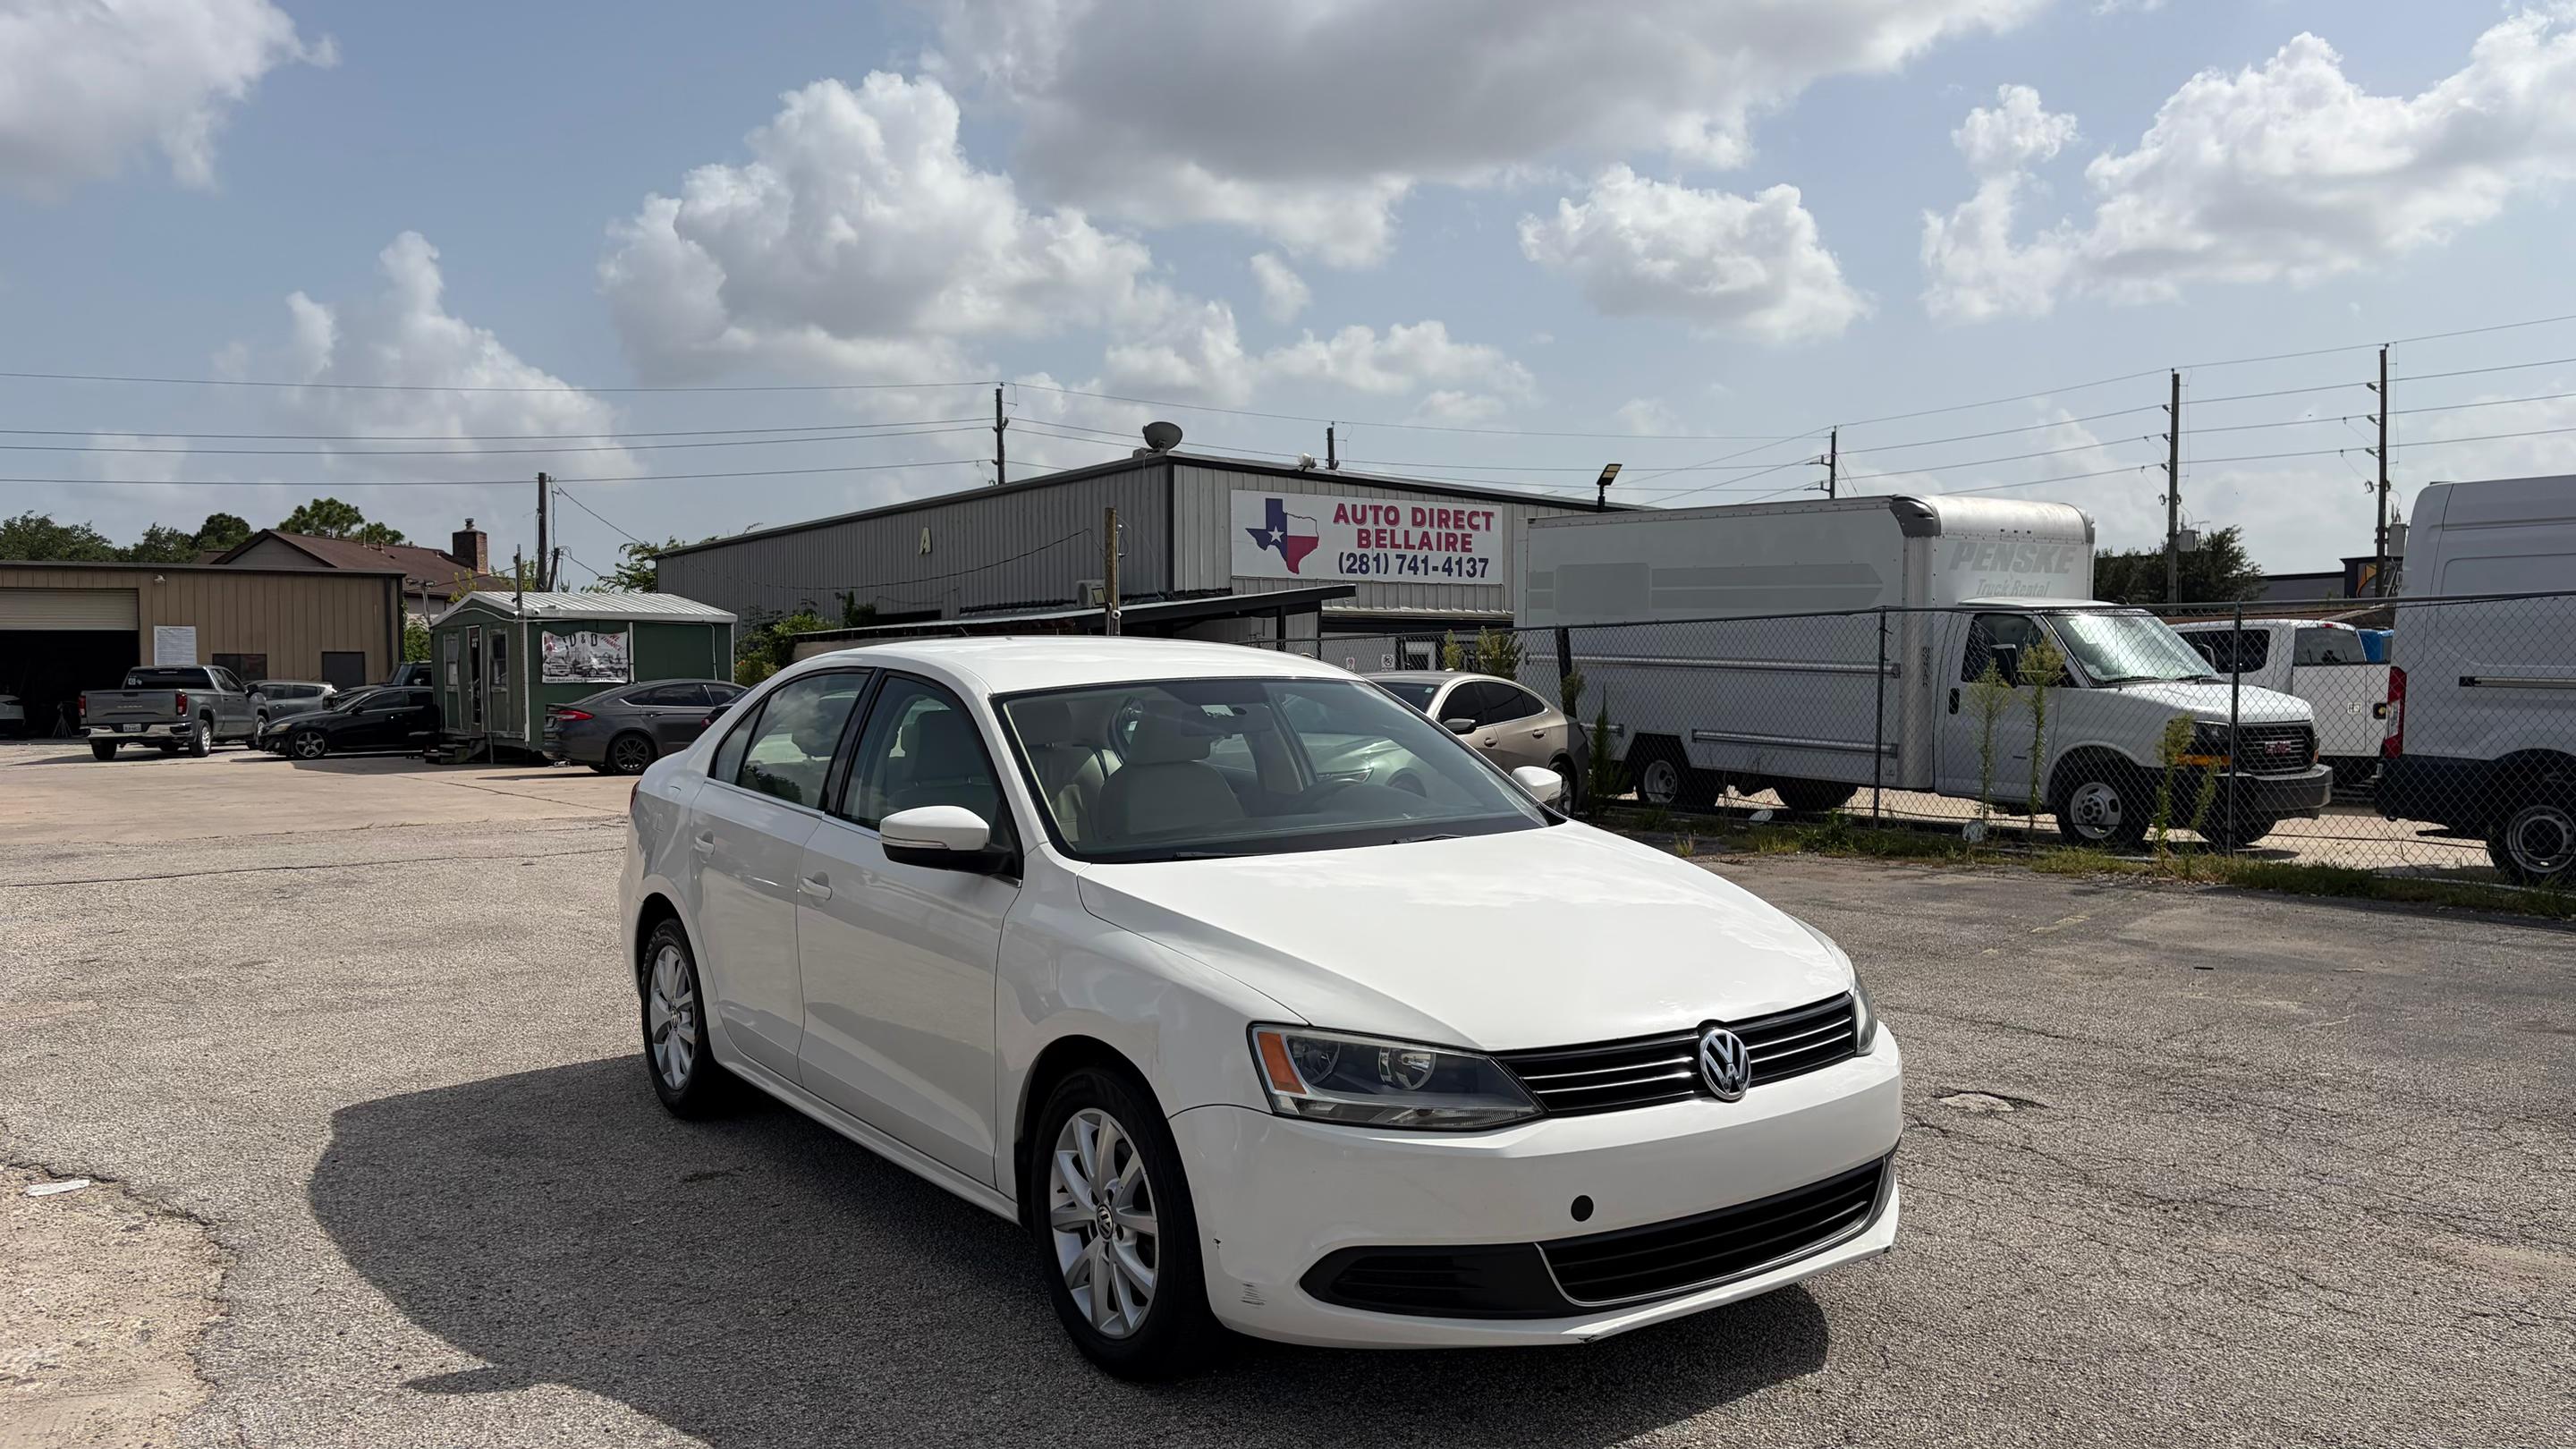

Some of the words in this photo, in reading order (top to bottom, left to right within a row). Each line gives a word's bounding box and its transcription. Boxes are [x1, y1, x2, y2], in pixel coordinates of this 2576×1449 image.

[1333, 503, 1401, 527] AUTO
[1411, 506, 1496, 532] DIRECT
[919, 527, 932, 555] A
[1357, 528, 1473, 553] BELLAIRE
[1338, 552, 1389, 574] (281)
[1395, 554, 1489, 578] 741-4137
[1949, 542, 2077, 574] PENSKE
[1976, 579, 2011, 597] Truck
[2012, 580, 2051, 597] Rental
[590, 633, 598, 647] D
